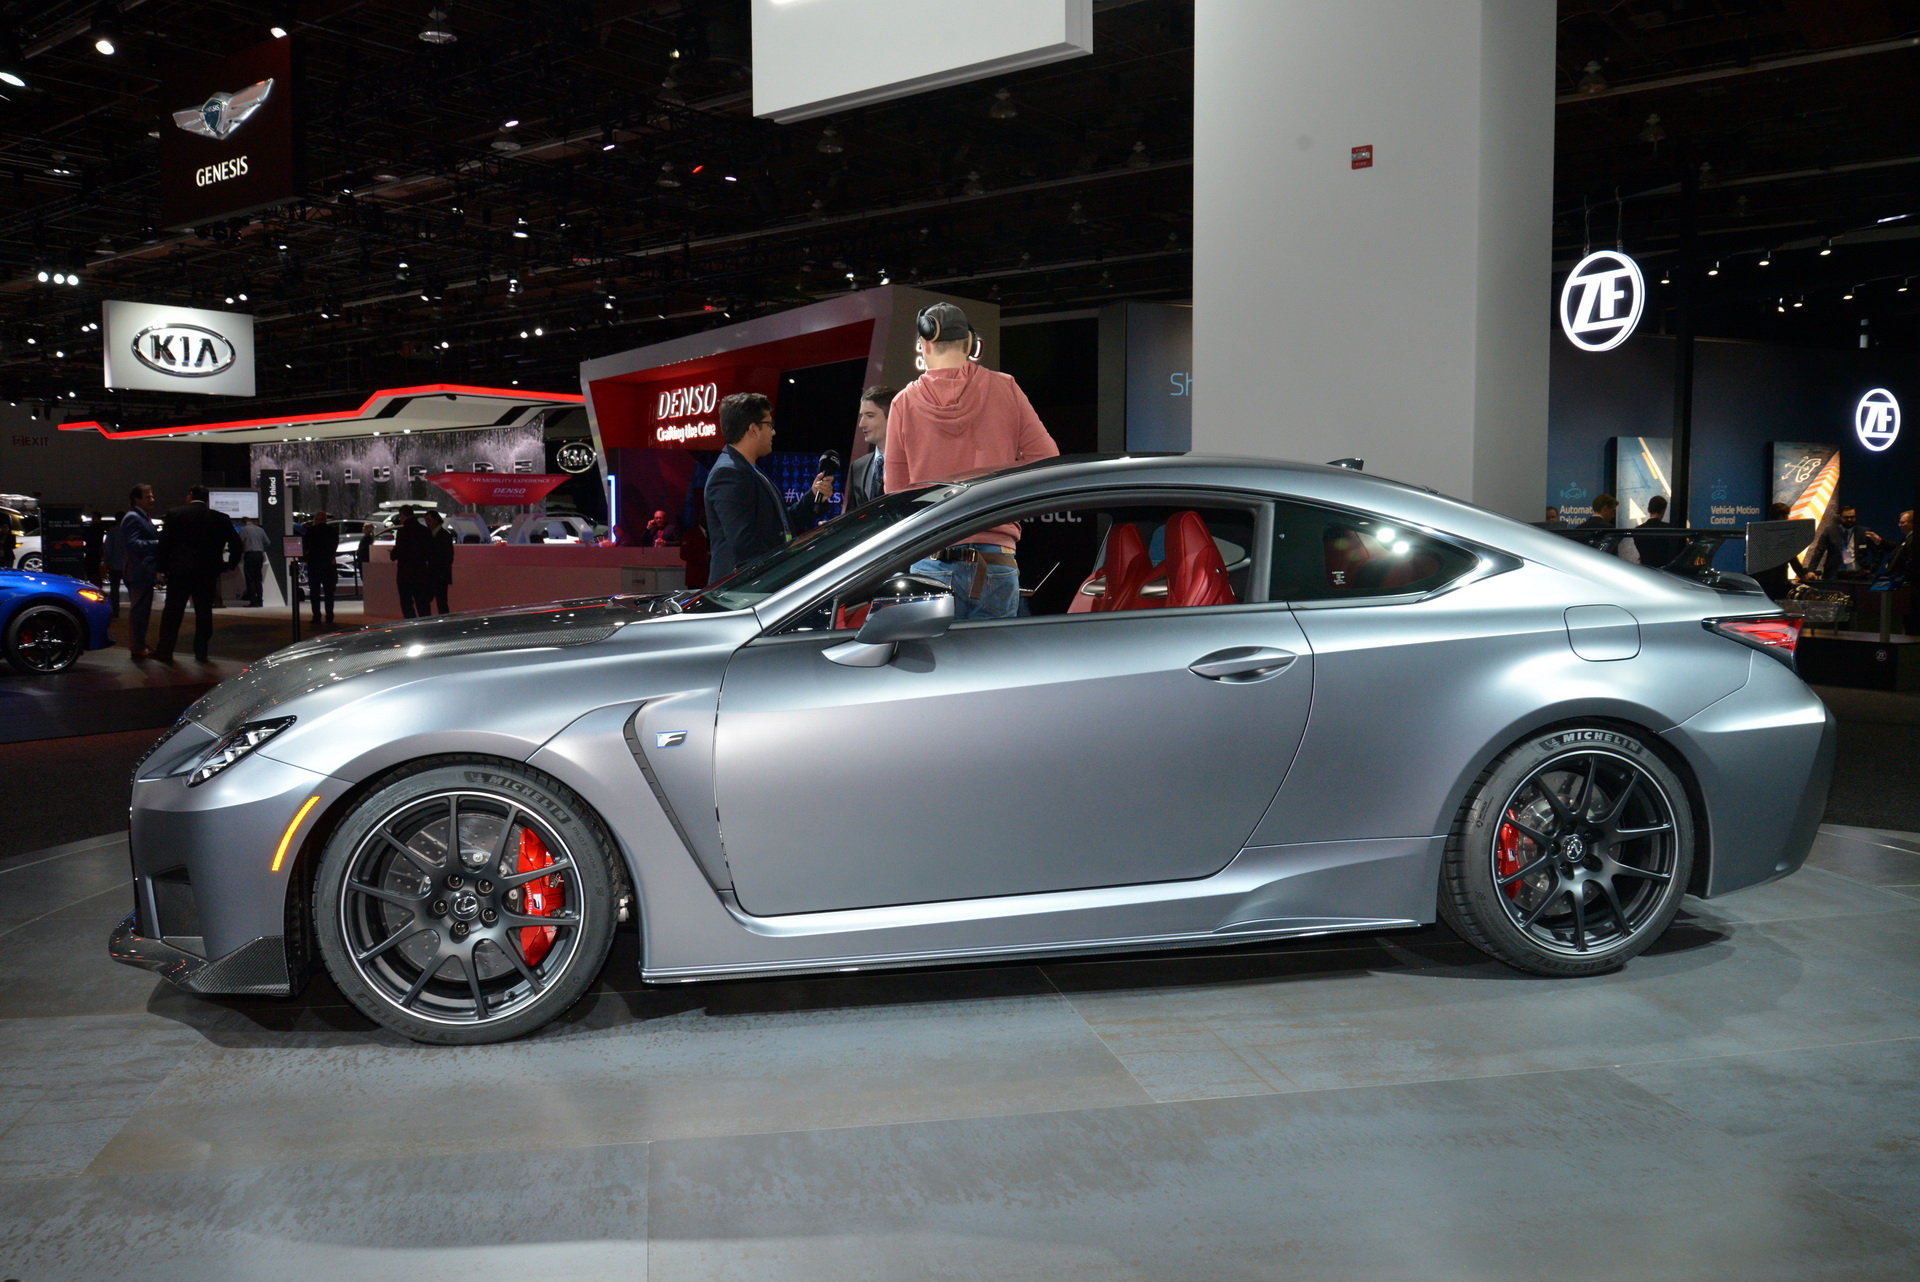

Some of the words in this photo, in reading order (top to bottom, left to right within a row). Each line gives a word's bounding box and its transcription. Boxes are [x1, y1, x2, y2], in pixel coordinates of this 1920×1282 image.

[196, 155, 249, 187] GENESIS
[1562, 262, 1640, 338] ZF
[149, 334, 219, 368] KIA
[656, 382, 718, 421] DENSO
[656, 424, 685, 444] Crafting
[685, 423, 698, 439] the
[698, 421, 717, 438] Core
[1856, 396, 1900, 443] ZF
[563, 449, 590, 466] KIA
[256, 459, 534, 488] ELLURIDE
[1560, 505, 1594, 514] Automat
[1711, 505, 1735, 515] Vehicle
[1736, 505, 1760, 515] Motion
[1711, 515, 1736, 525] Control
[1562, 731, 1641, 752] MICHELIN
[488, 775, 569, 823] MICHELIN
